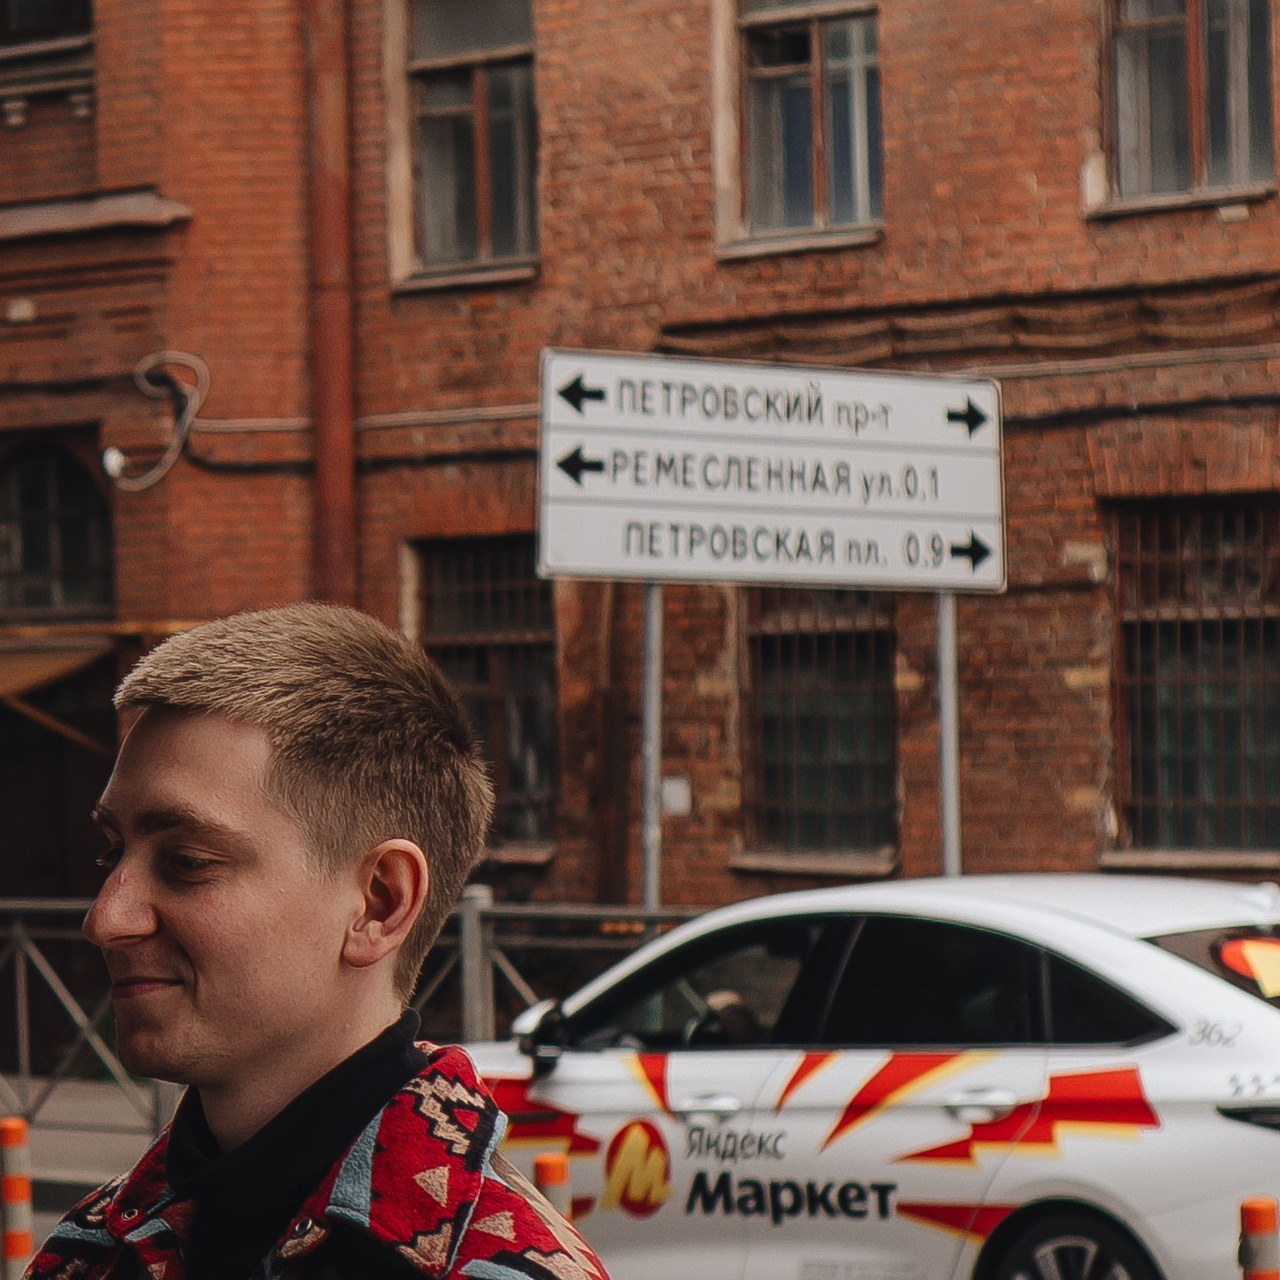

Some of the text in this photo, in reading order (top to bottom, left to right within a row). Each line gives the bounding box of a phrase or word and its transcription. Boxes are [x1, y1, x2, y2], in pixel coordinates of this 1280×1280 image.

[618, 378, 892, 437] ПЕТРОВСКИЙ пр-т
[611, 450, 852, 496] РЕМЕСЛЕННАЯ
[625, 520, 836, 563] ПЕТРОВСКАЯ
[847, 539, 888, 566] пл.
[685, 1125, 787, 1162] Яндекс
[684, 1171, 897, 1225] Маркет
